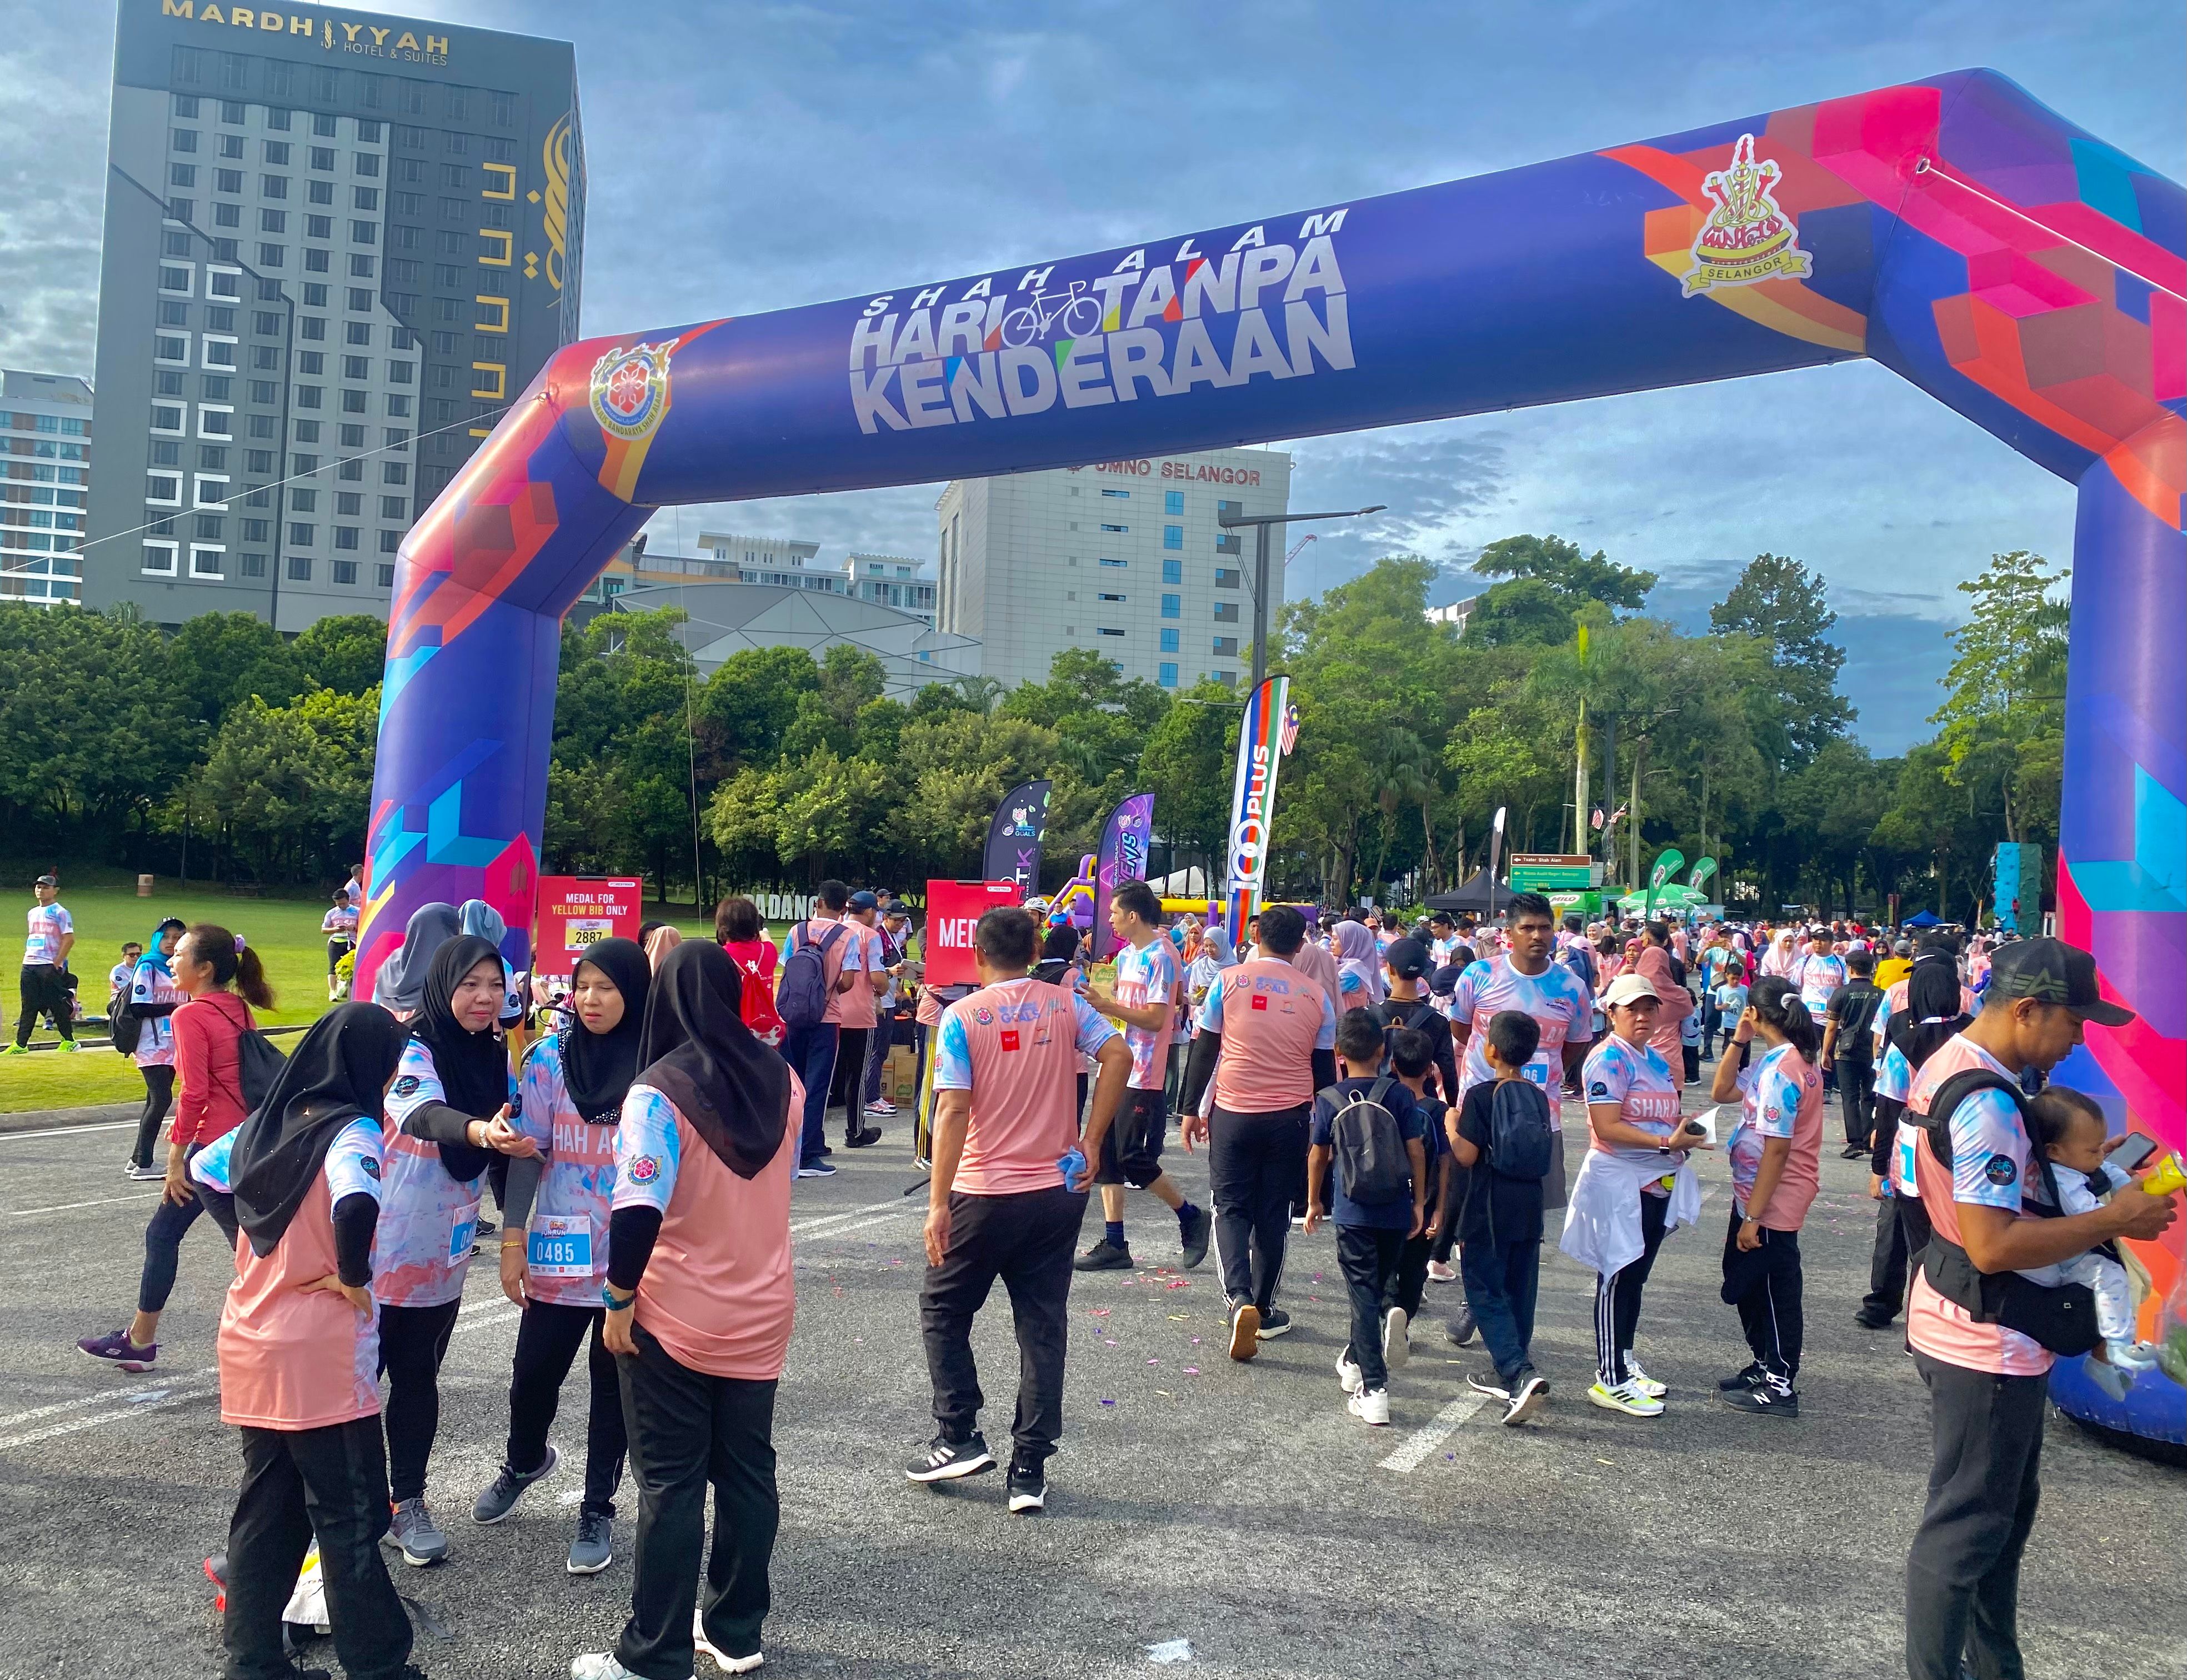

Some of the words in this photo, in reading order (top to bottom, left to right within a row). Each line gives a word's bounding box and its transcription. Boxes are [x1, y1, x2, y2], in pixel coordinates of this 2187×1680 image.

[344, 42, 384, 57] HOTEL
[390, 48, 398, 59] &
[404, 51, 448, 67] SUITES
[862, 266, 1056, 317] SHAH
[1113, 208, 1349, 274] ALAM
[1708, 257, 1783, 278] SELANGOR
[849, 294, 1007, 371] HARI
[1092, 234, 1347, 333] TANPA
[849, 296, 1358, 436] KENDERAAN
[642, 414, 655, 430] SHAH
[1161, 462, 1261, 487] SELANGOR
[1655, 869, 1664, 884] MILO
[1692, 872, 1702, 888] MILO
[566, 893, 595, 904] MEDAL
[598, 893, 614, 904] FOR
[552, 904, 587, 915] YELLOW
[589, 905, 604, 915] BIB
[606, 905, 628, 916] ONLY
[575, 932, 602, 944] 2887
[1629, 1098, 1670, 1118] SHAH
[552, 1123, 589, 1154] HAH
[537, 1242, 574, 1262] 0485
